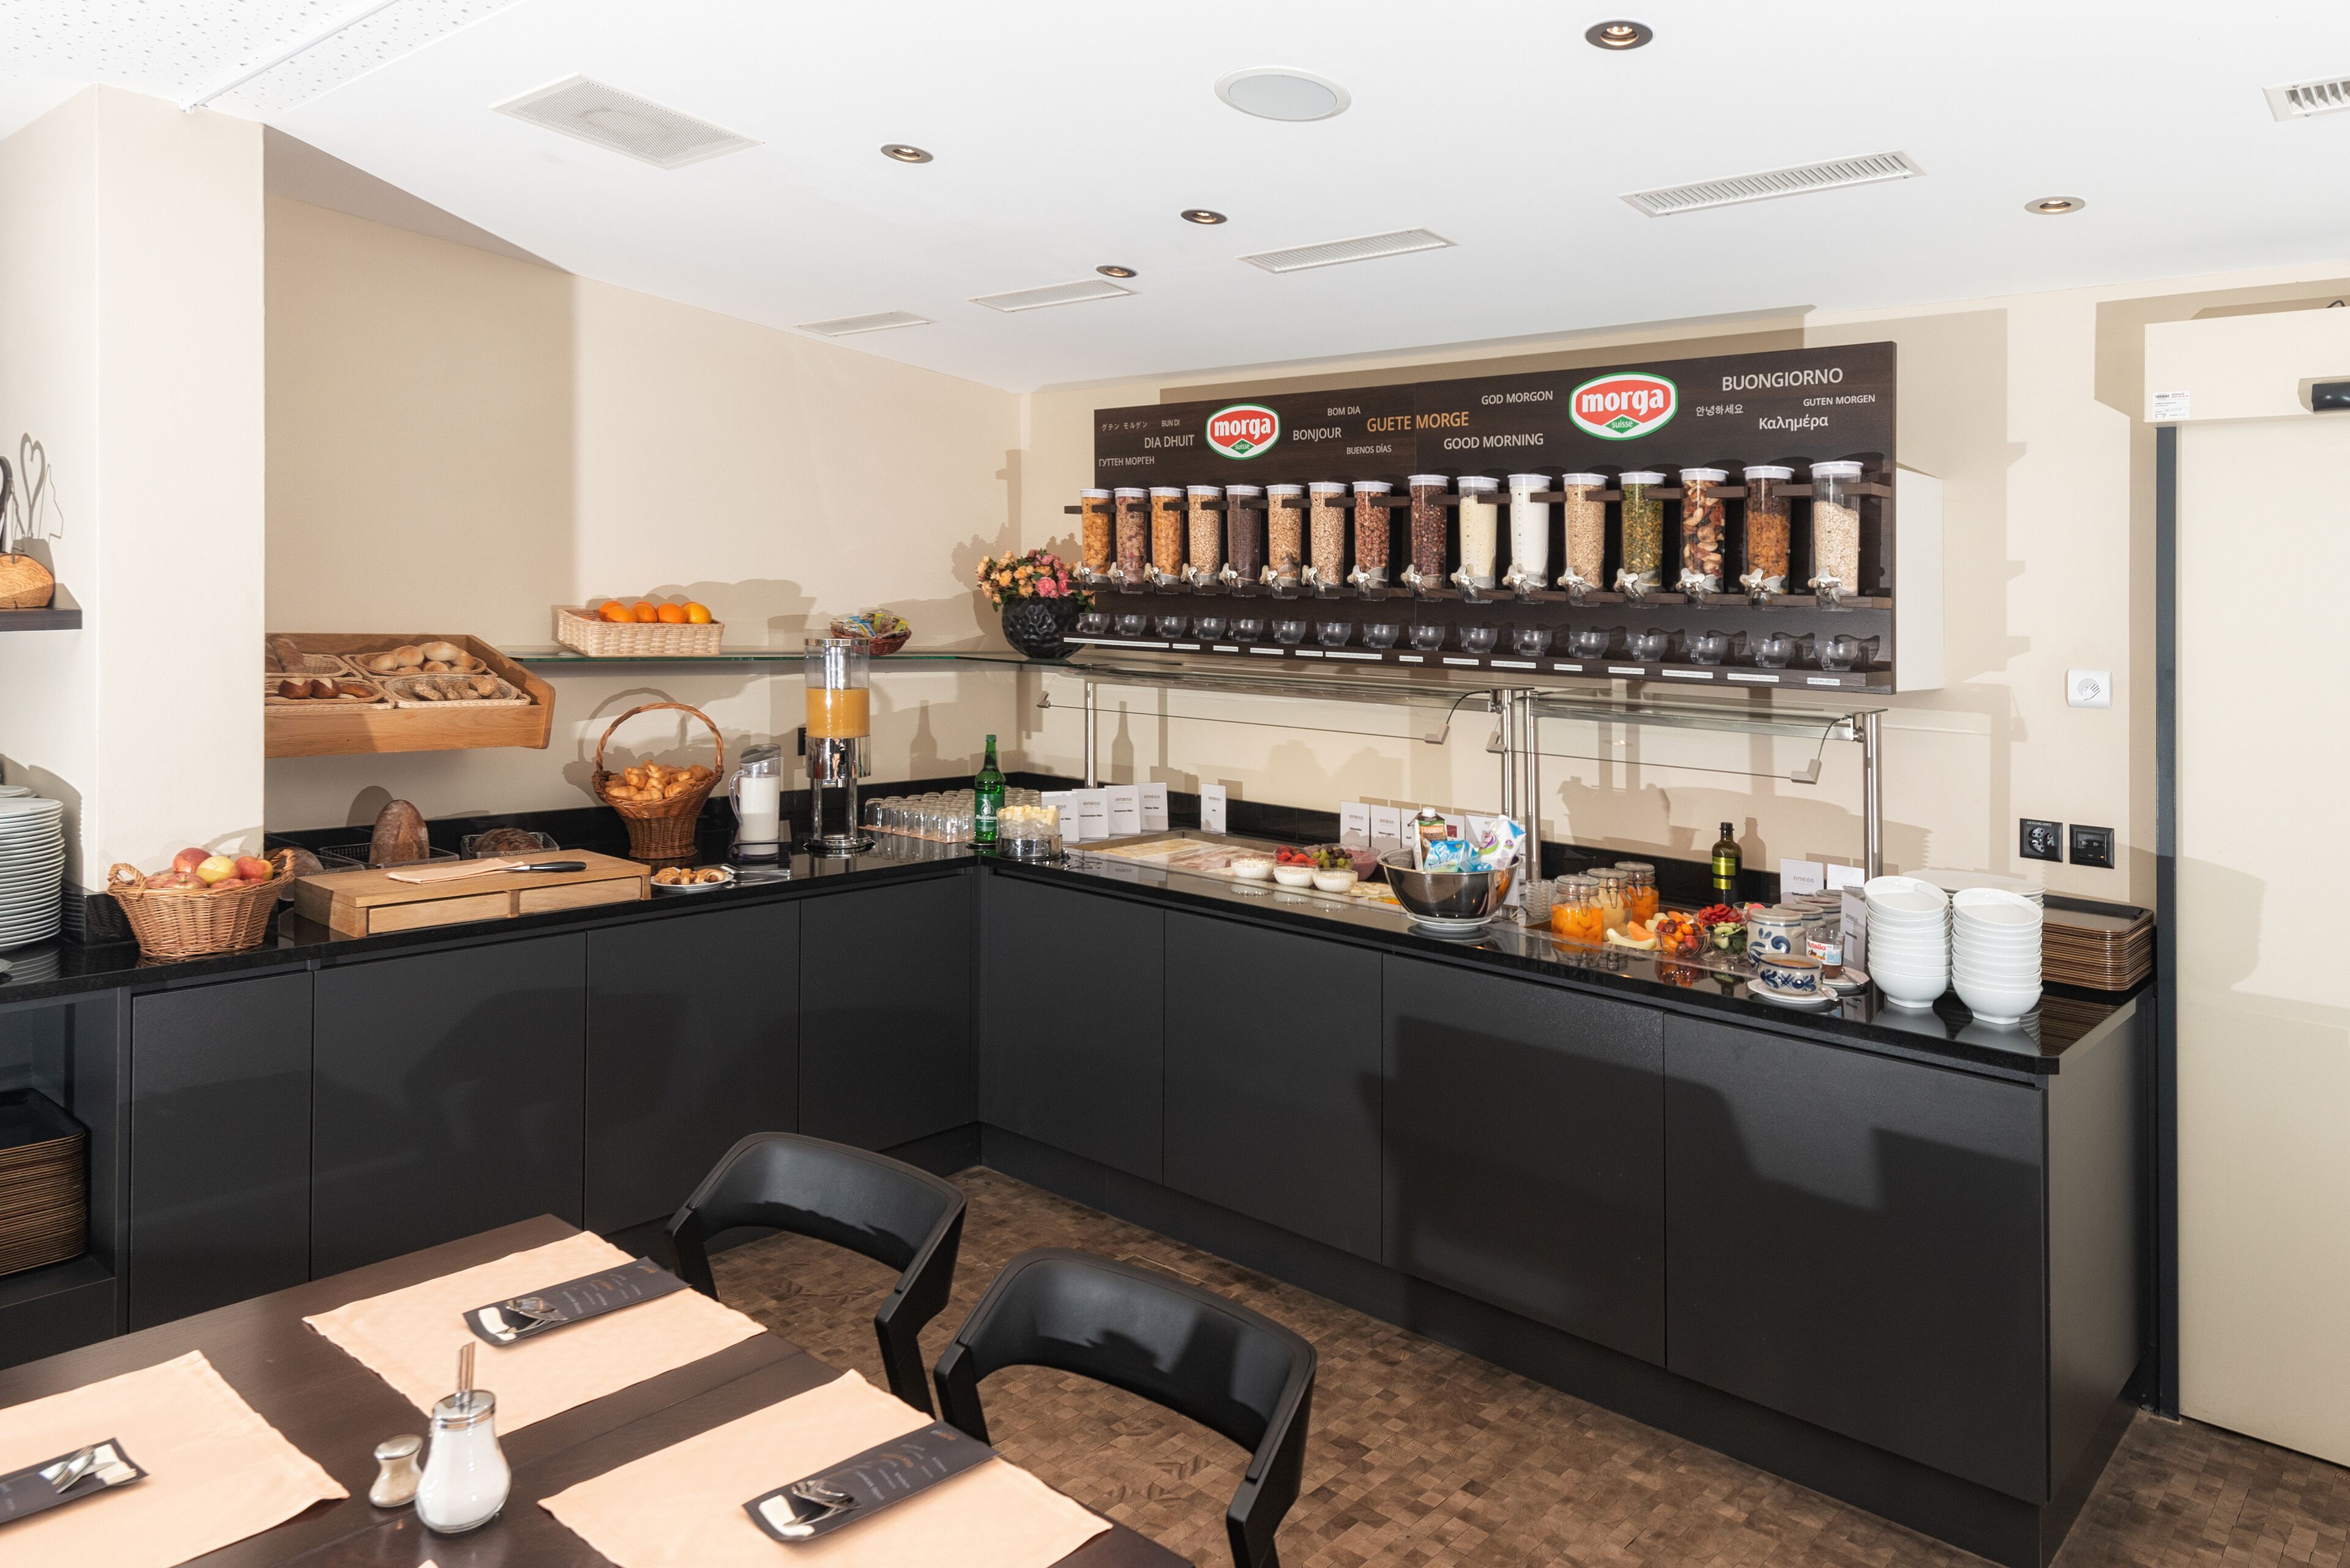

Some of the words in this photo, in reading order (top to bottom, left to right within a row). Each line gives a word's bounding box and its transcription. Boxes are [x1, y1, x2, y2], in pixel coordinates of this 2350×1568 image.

[1722, 367, 1843, 391] BUONGIORNO
[1481, 395, 1504, 405] GOD
[1506, 390, 1553, 403] MORGON
[1581, 389, 1664, 416] morga
[1803, 397, 1833, 406] GUTEN
[1835, 394, 1876, 405] MORGEN
[1327, 406, 1345, 416] BOM
[1347, 406, 1361, 415] DIA
[1696, 404, 1744, 417] 안녕하세요
[1214, 417, 1271, 440] morga
[1367, 416, 1412, 432] GUETE
[1416, 411, 1469, 429] MORGE
[1611, 419, 1633, 428] suisse
[1758, 414, 1829, 431] Καλημέρα
[1292, 427, 1342, 442] BONJOUR
[1443, 436, 1480, 450] GOOD
[1483, 433, 1545, 448] MORNING
[1144, 437, 1162, 449] DIA
[1163, 435, 1195, 447] DHUIT
[1234, 442, 1250, 451] suisse
[1346, 446, 1375, 455] BUENOS
[1376, 443, 1392, 453] DÍAS
[1099, 457, 1124, 467] ГУТТЕН
[1125, 456, 1155, 466] МОРГЕН
